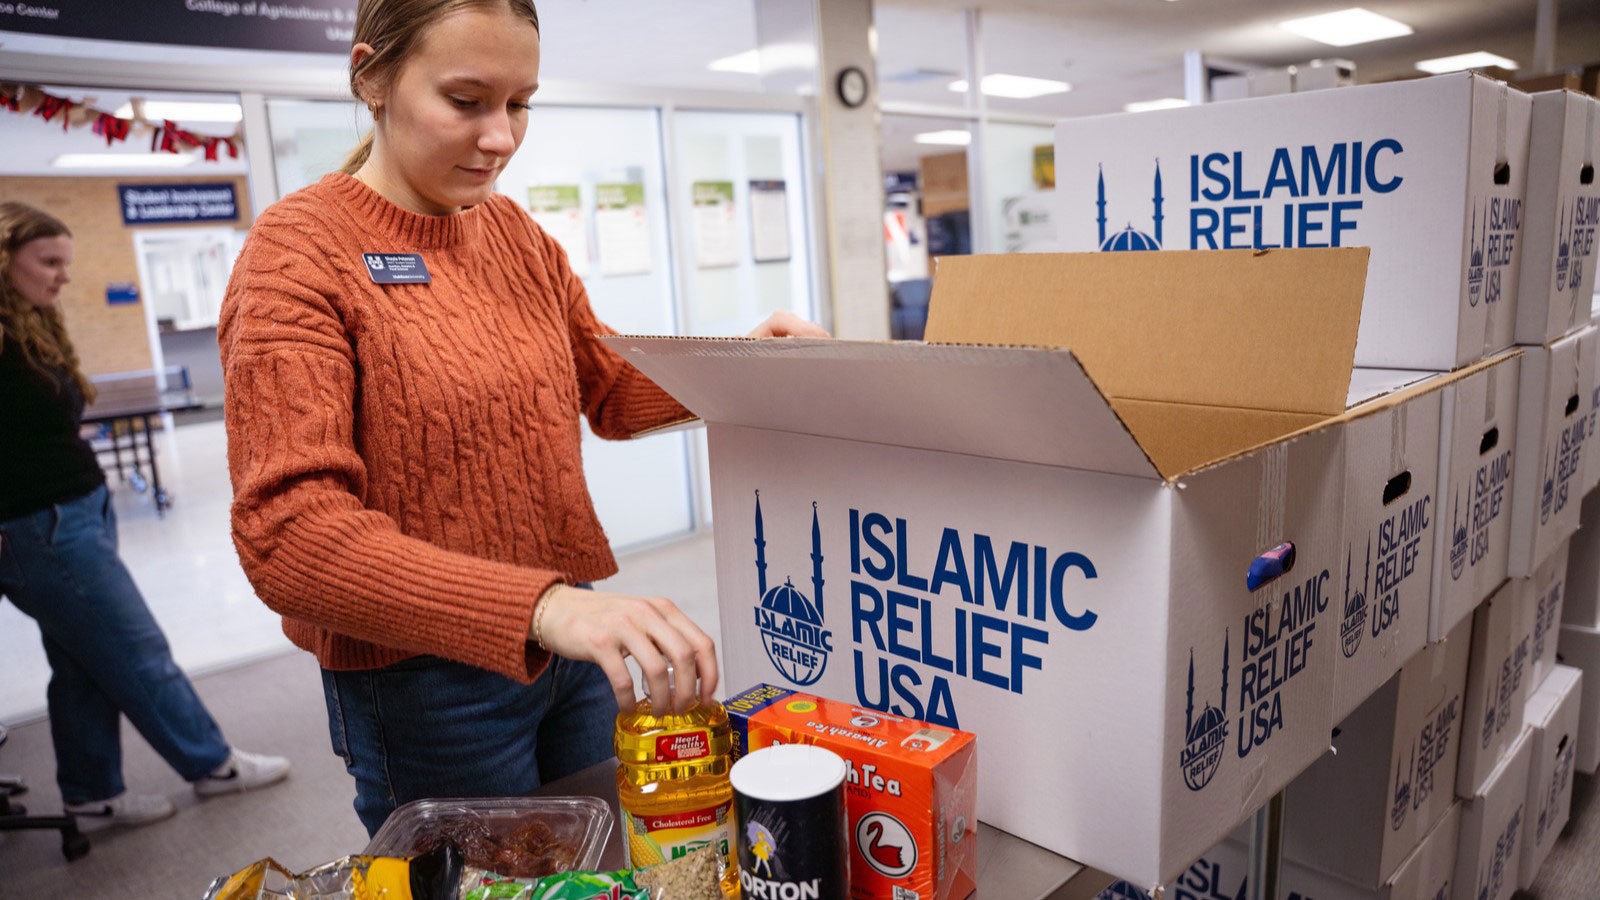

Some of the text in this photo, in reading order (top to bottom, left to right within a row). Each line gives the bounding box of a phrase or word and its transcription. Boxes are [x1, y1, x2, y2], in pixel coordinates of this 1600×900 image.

[241, 2, 257, 15] of
[1189, 138, 1405, 203] ISLAMIC
[1189, 201, 1364, 250] RELIEF
[1489, 196, 1522, 231] ISLAMIC
[1487, 233, 1515, 267] RELIEF
[1485, 269, 1501, 304] USA
[1475, 449, 1512, 501] ISLAMIC
[1377, 494, 1431, 560] ISLAMIC
[1472, 484, 1504, 535] RELIEF
[849, 508, 1099, 632] ISLAMIC
[1374, 536, 1421, 600] RELIEF
[1470, 526, 1489, 567] USA
[754, 606, 833, 653] ISLAMIC
[850, 579, 1049, 696] RELIEF
[1243, 569, 1330, 662] ISLAMIC
[1371, 588, 1400, 638] USA
[771, 641, 818, 670] RELIEF
[1240, 622, 1316, 713] RELIEF
[853, 648, 960, 730] USA
[671, 741, 705, 751] Healthy
[675, 734, 700, 744] Heart
[1180, 719, 1230, 769] ISLAMIC
[1237, 691, 1283, 758] USA
[861, 763, 902, 797] Tea
[1190, 749, 1219, 780] RELIEF
[652, 817, 695, 829] Cholesterol
[696, 814, 712, 823] Free
[739, 864, 820, 900] ORTON
